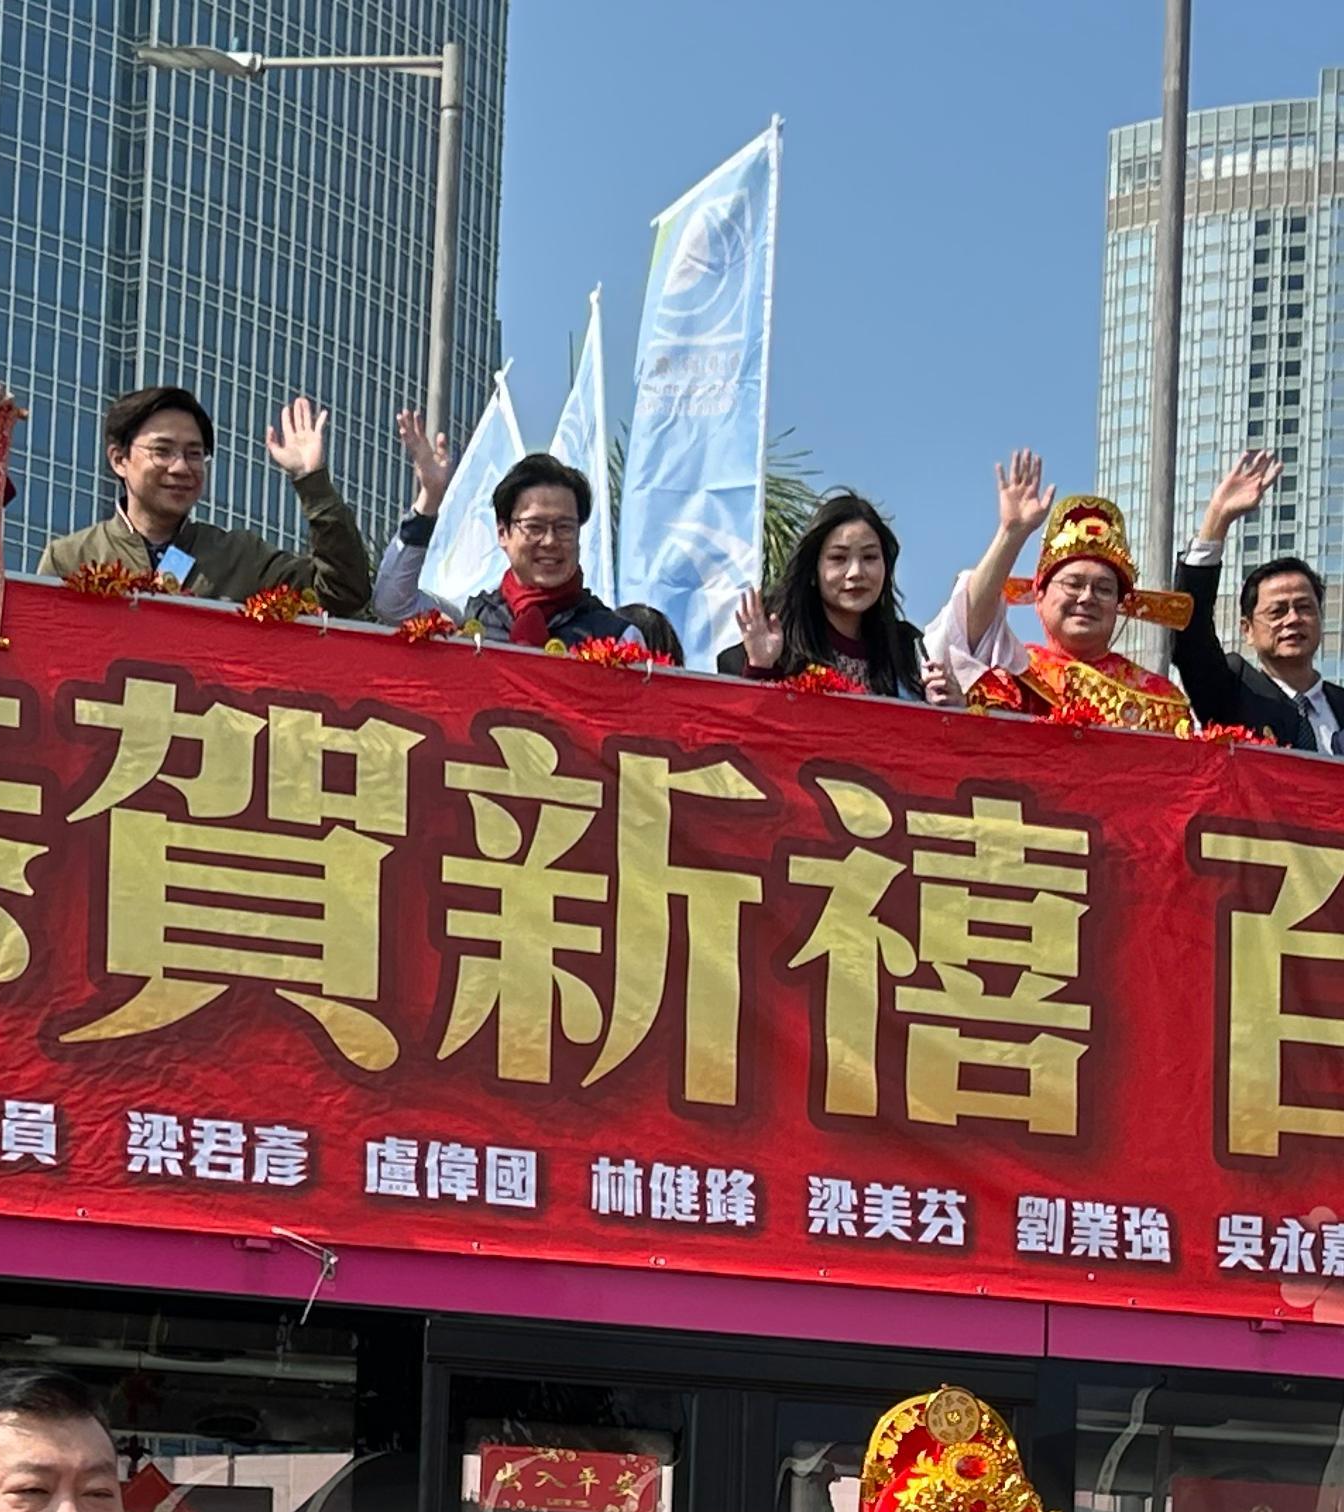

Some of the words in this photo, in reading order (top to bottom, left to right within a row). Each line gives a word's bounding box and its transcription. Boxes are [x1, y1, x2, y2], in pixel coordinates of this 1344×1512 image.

[127, 1111, 309, 1187] 梁君彥
[365, 1136, 538, 1208] 盧偉國
[591, 1156, 757, 1228] 林健鋒
[808, 1175, 968, 1247] 梁美芬
[1017, 1195, 1172, 1264] 劉業強
[496, 1461, 640, 1501] 出入平安
